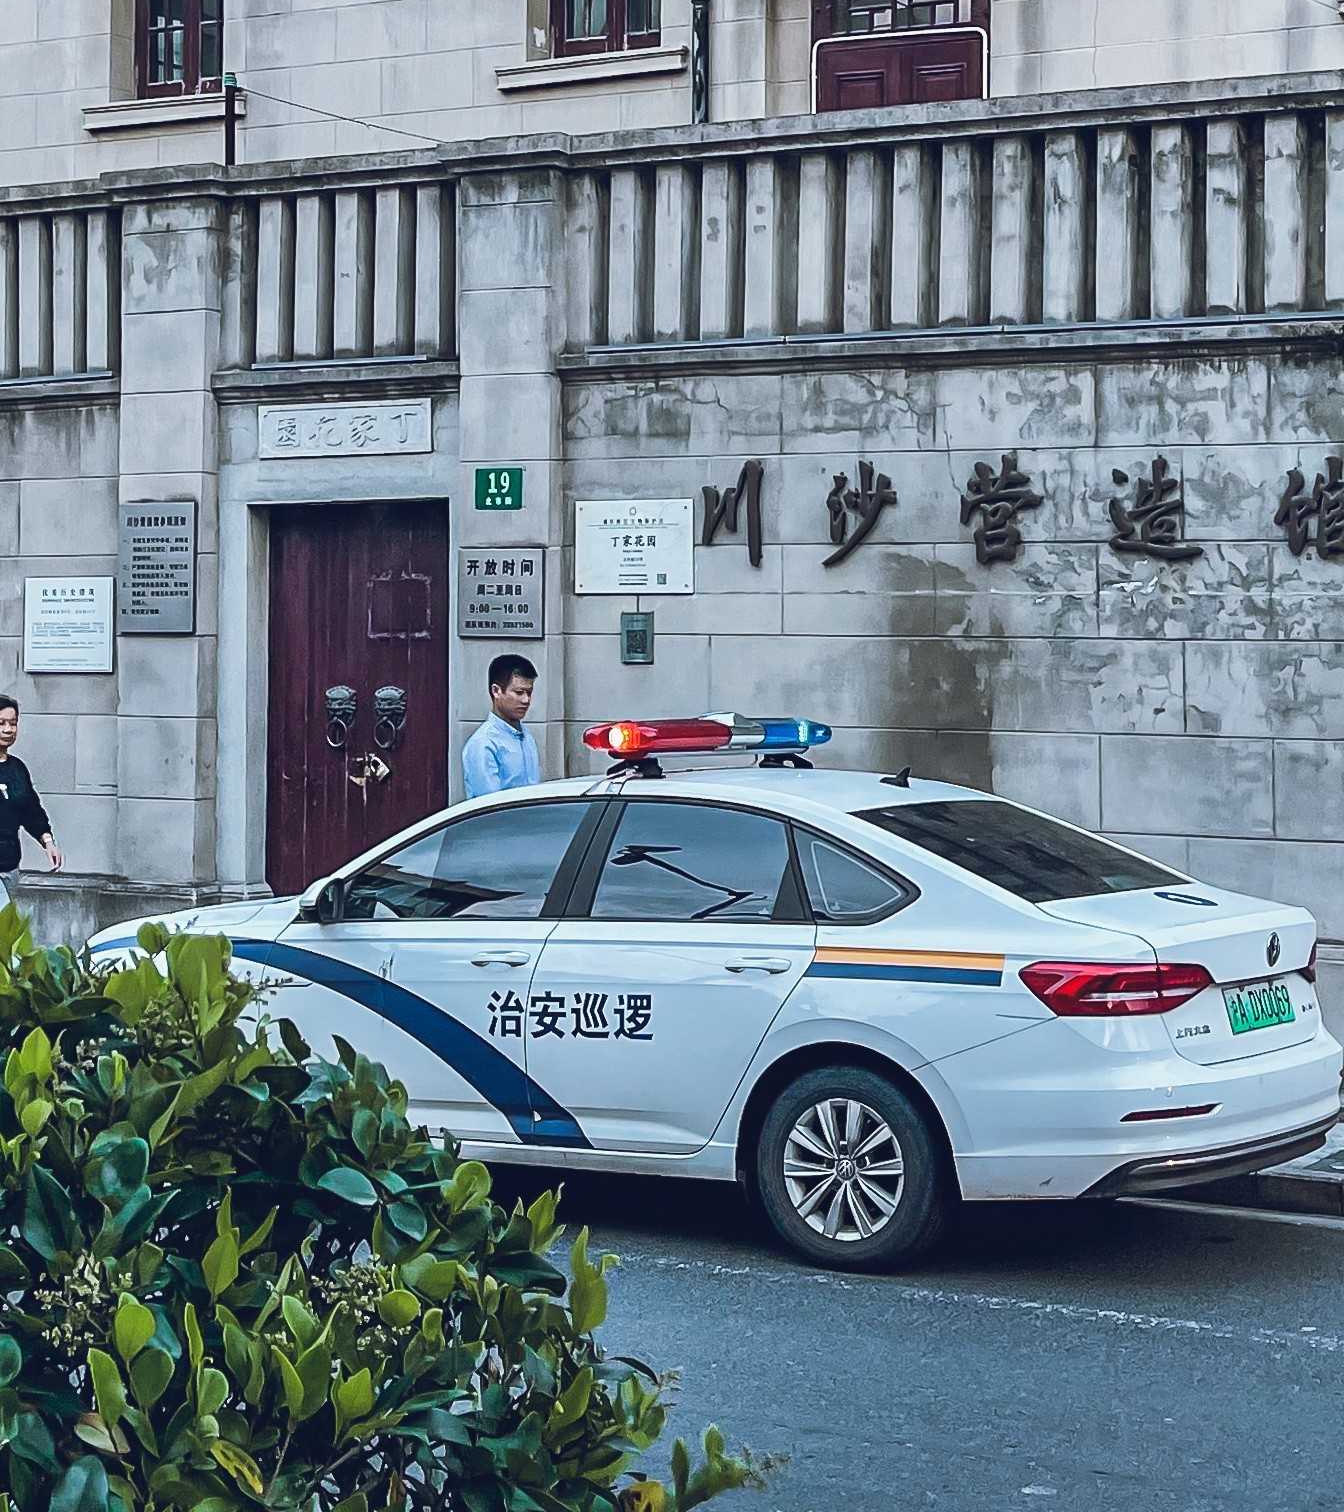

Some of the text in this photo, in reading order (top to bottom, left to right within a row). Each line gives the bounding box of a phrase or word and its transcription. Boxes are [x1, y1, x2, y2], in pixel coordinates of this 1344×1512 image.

[487, 471, 510, 494] 19
[610, 534, 657, 548] 丁家花园
[466, 559, 534, 576] 开放时间
[476, 584, 522, 596] 周二至周日
[486, 990, 654, 1040] 治安巡逻
